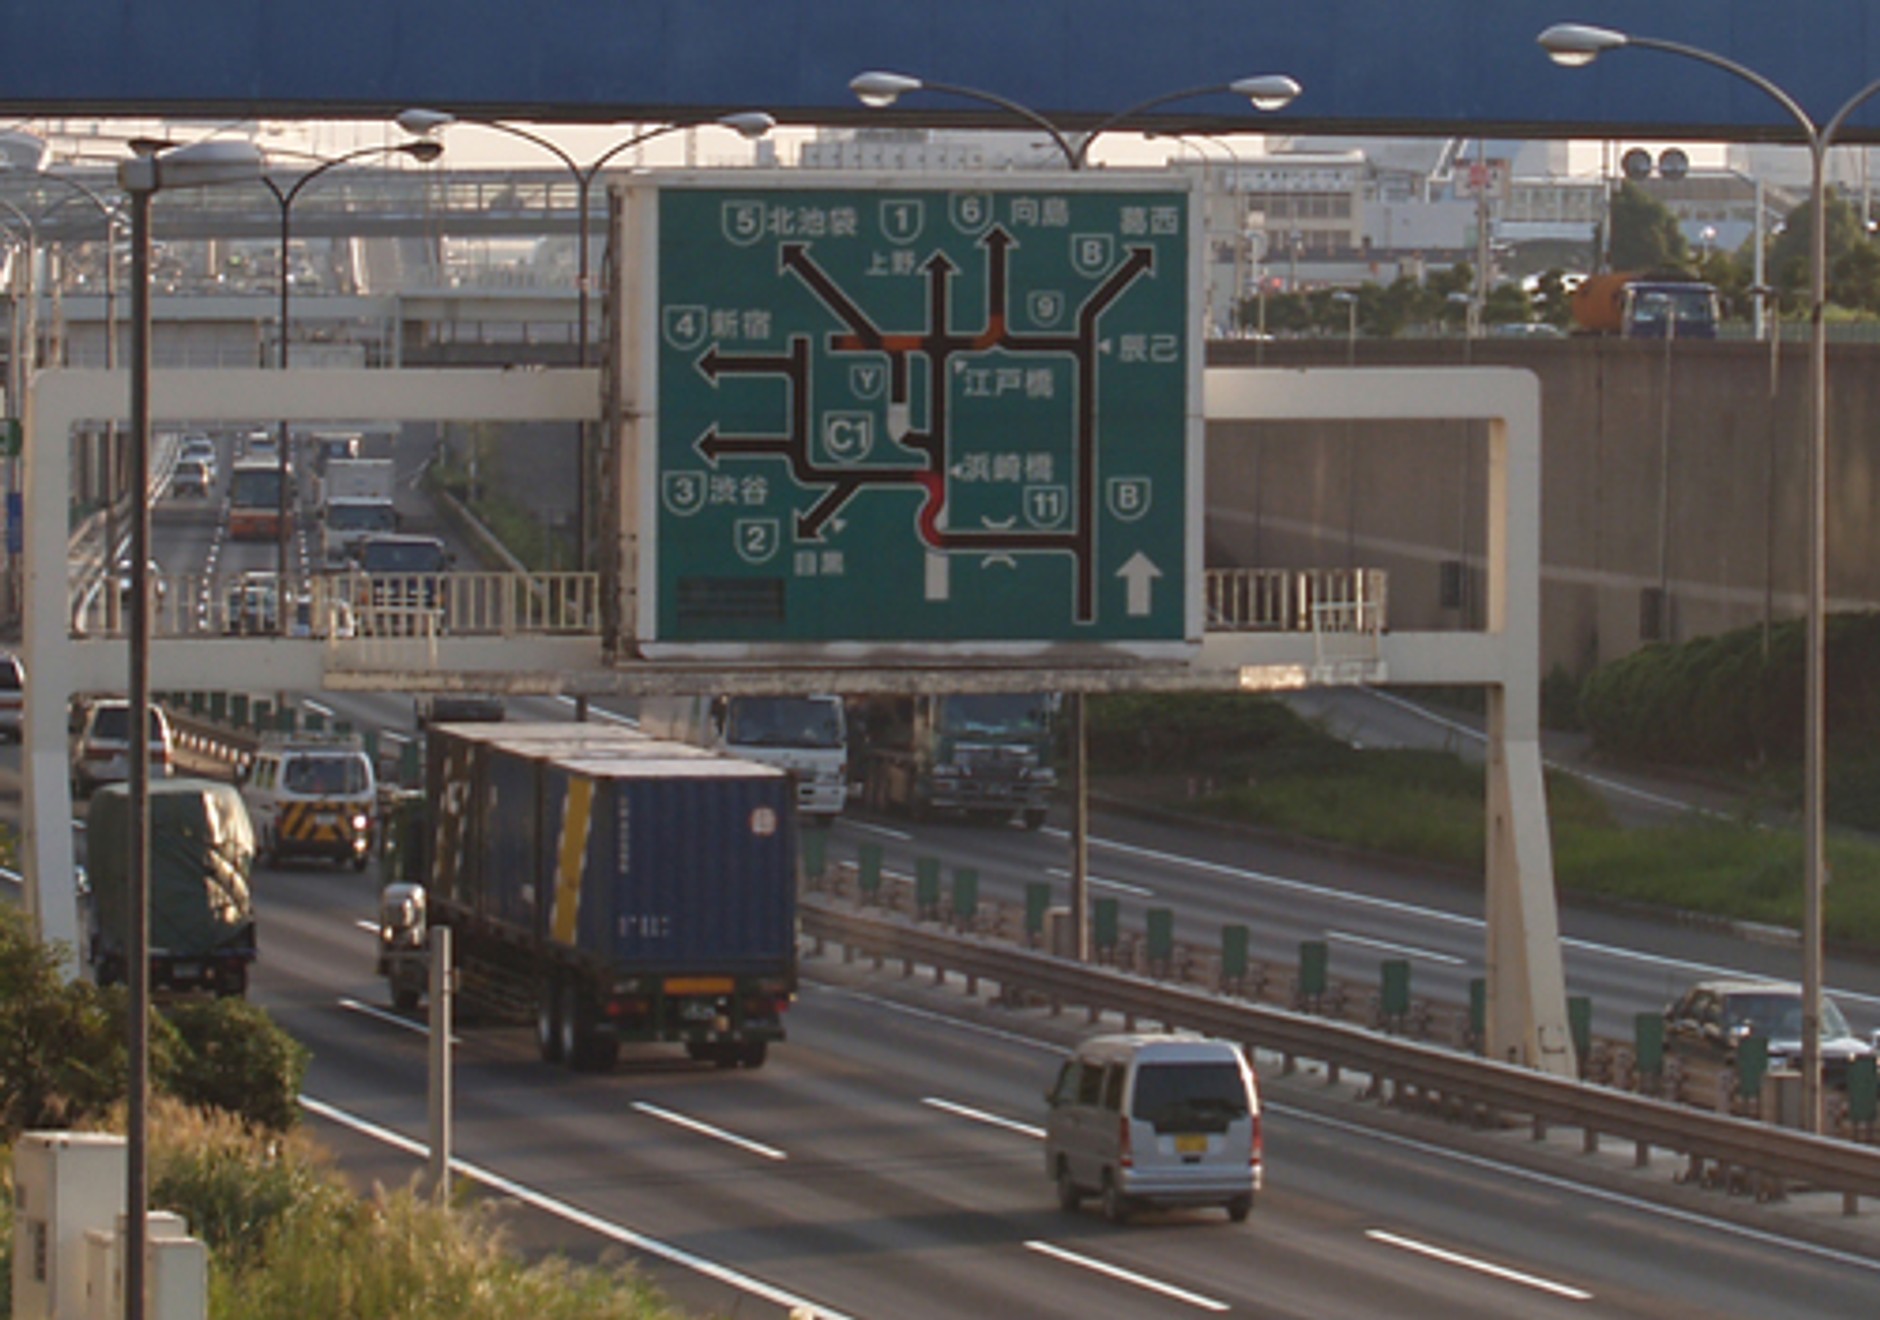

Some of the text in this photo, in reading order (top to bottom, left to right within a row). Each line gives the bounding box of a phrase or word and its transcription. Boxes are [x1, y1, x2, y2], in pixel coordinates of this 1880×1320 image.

[735, 207, 756, 235] 5
[765, 206, 857, 236] 北池袋
[896, 206, 907, 231] 1
[962, 196, 981, 224] 6
[1011, 196, 1069, 226] 向島
[866, 250, 915, 275] 上野
[1038, 295, 1056, 320] 9
[676, 312, 695, 336] 4
[711, 310, 770, 338] 新宿
[859, 368, 875, 389] Y
[964, 367, 1053, 398] 江戸橋
[829, 419, 869, 449] C1
[674, 477, 694, 503] 3
[710, 476, 768, 504] 渋谷
[1119, 484, 1140, 509] B
[1033, 492, 1059, 518] 11
[748, 526, 765, 551] 2
